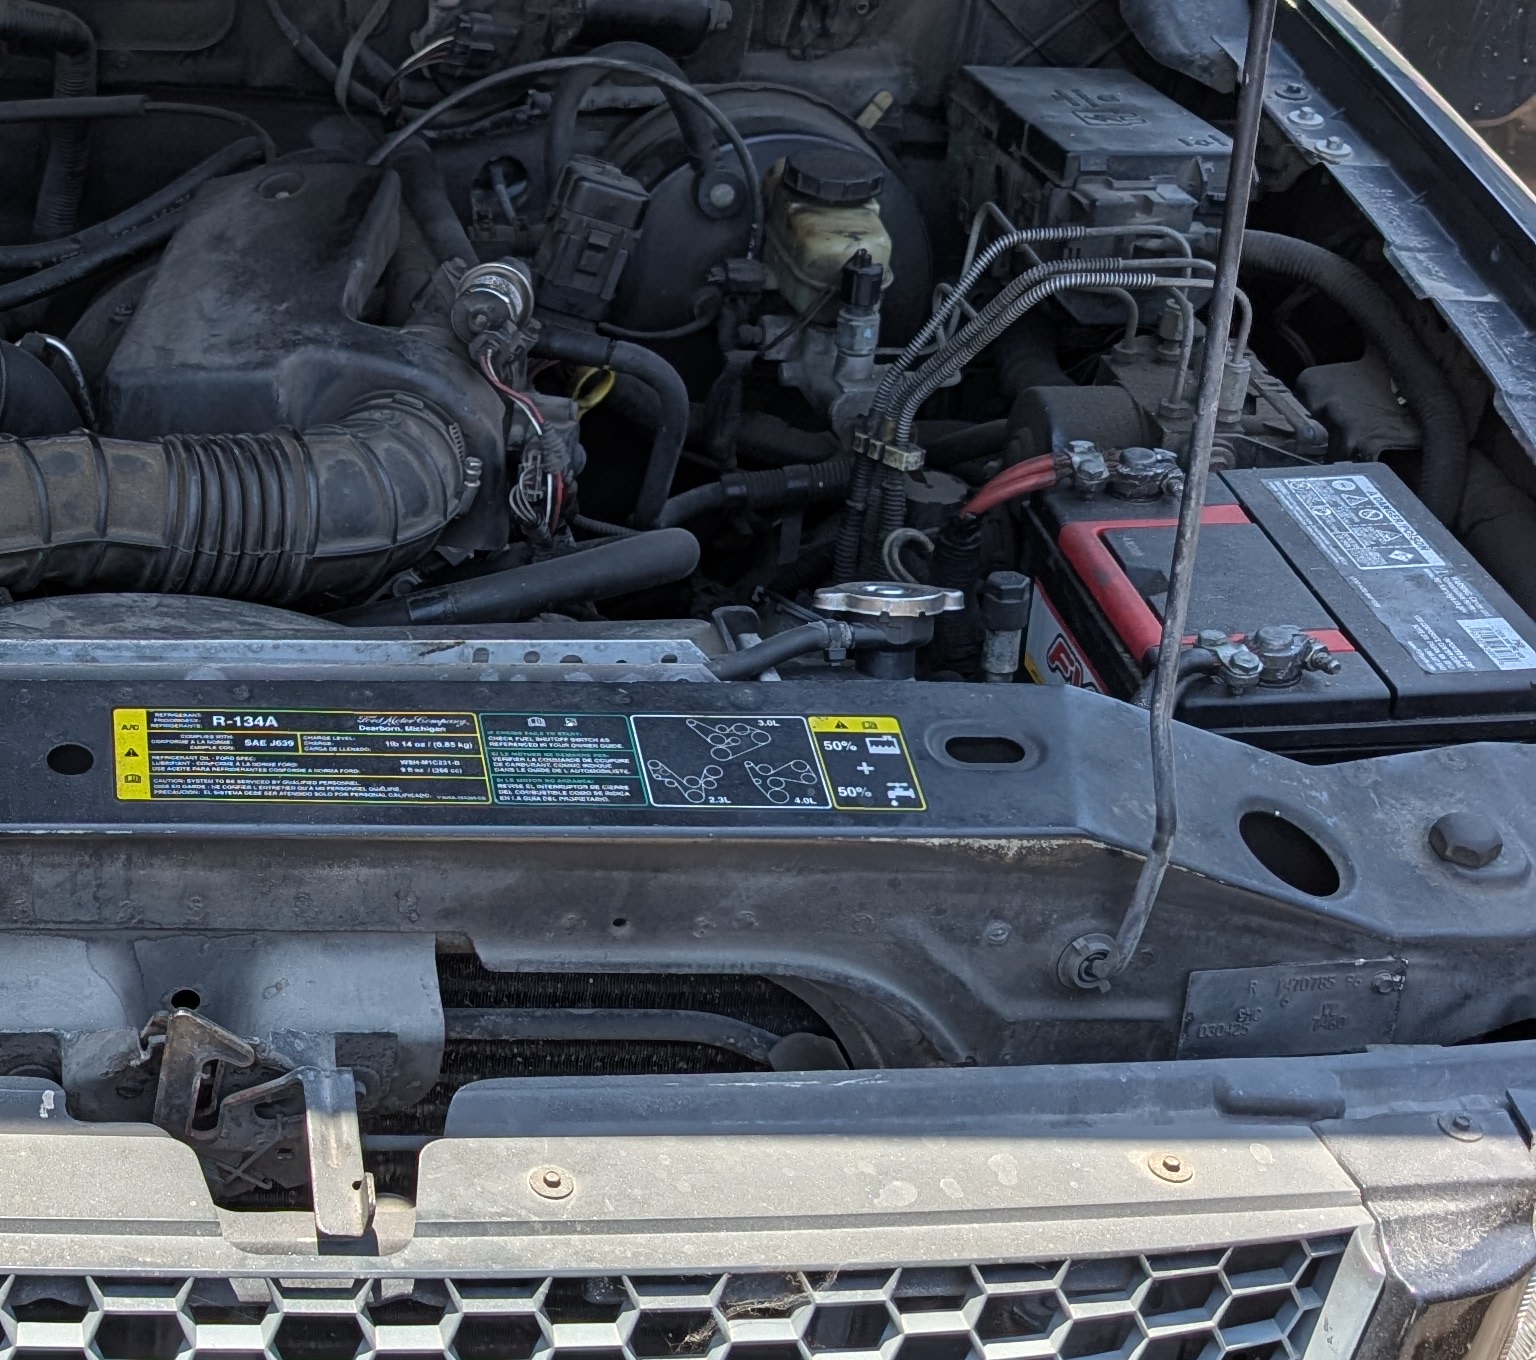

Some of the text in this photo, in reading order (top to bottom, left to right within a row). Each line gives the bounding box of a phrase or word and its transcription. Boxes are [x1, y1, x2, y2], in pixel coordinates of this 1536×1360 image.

[212, 715, 279, 727] R-134A
[357, 715, 382, 724] Ford
[381, 715, 415, 726] Motor
[758, 719, 780, 727] 3.0L
[823, 740, 858, 751] 50%
[837, 786, 872, 798] 50%
[708, 796, 732, 804] 2.3L
